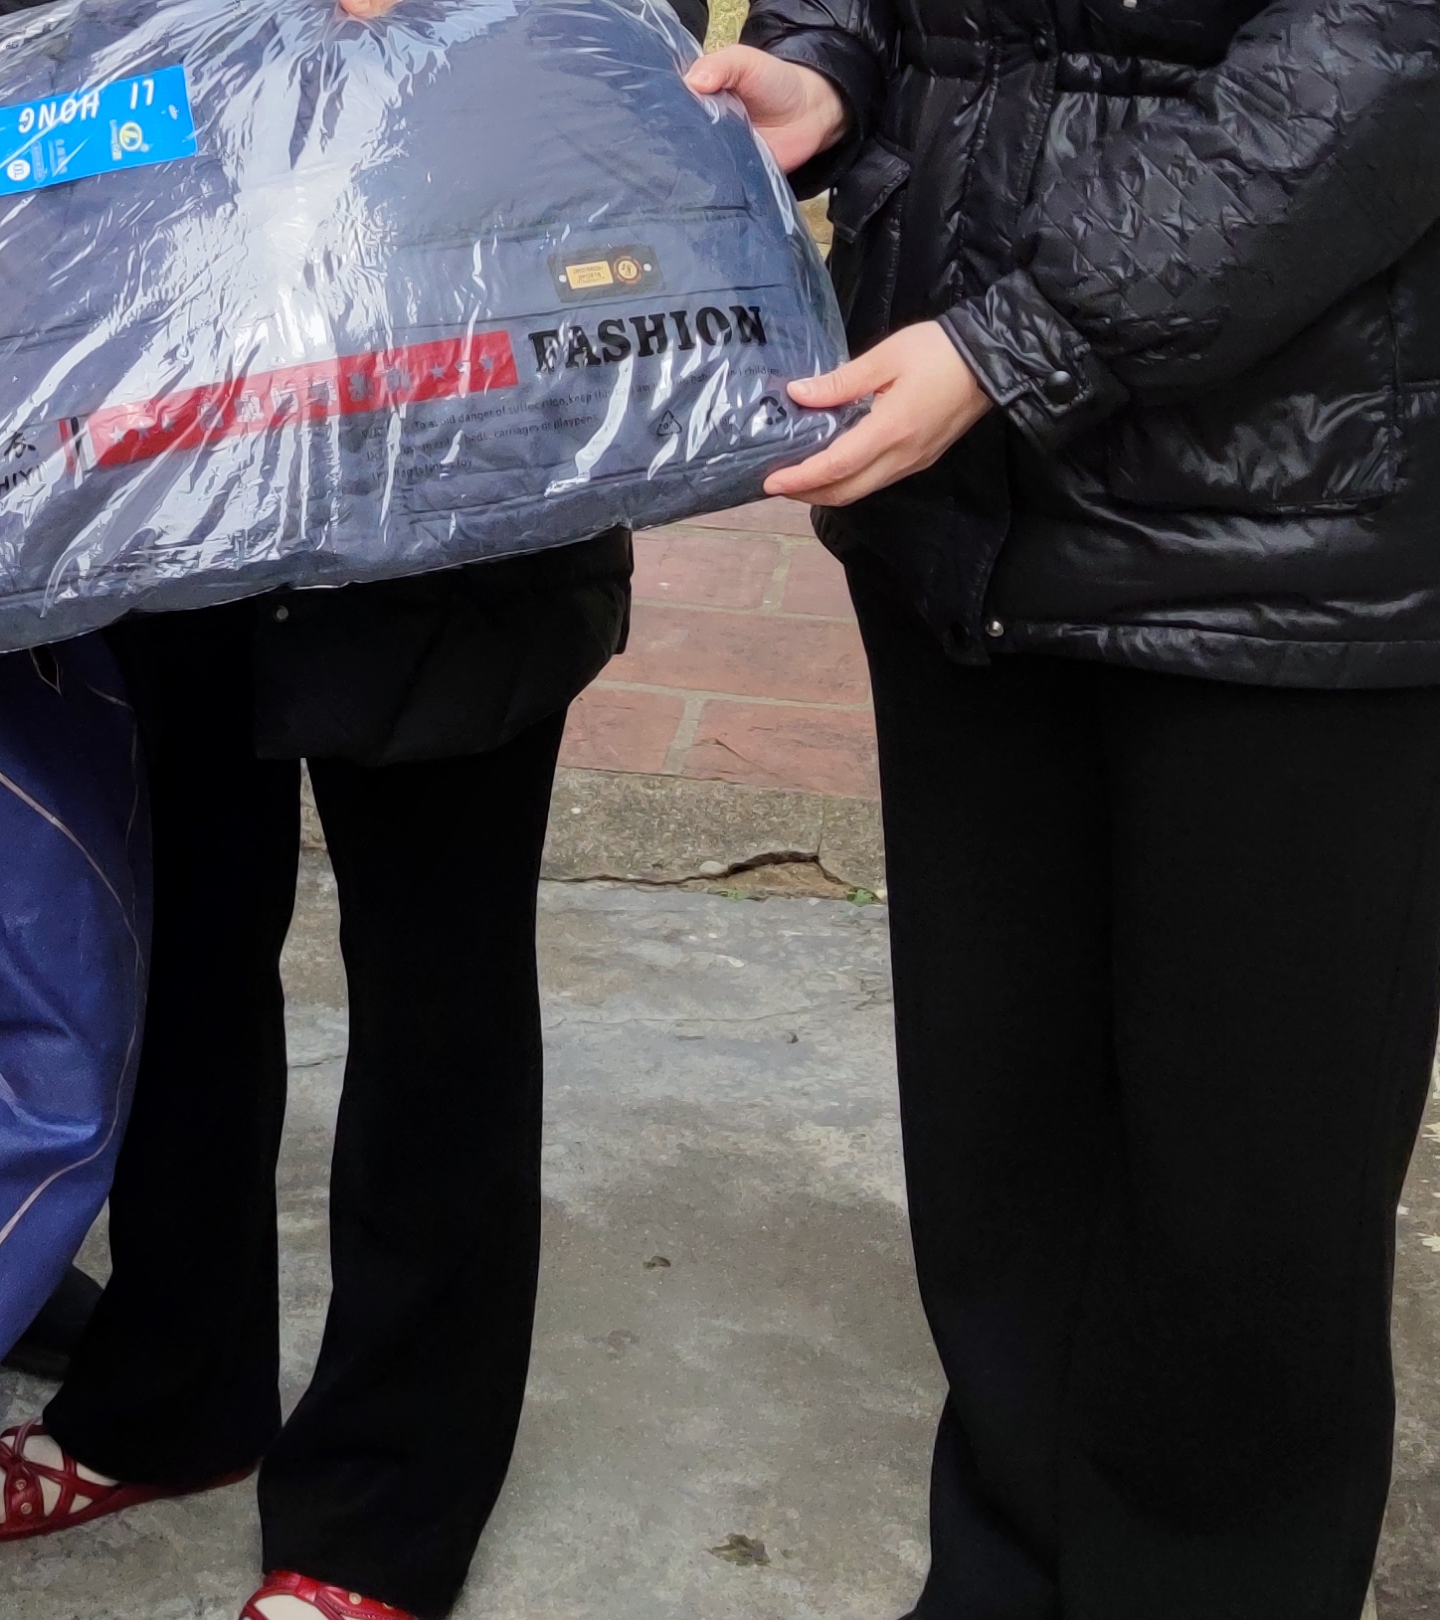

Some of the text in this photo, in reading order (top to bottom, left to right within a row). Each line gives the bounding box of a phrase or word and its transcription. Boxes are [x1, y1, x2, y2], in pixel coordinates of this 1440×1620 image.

[17, 90, 101, 135] HONG
[129, 78, 155, 110] LI
[528, 305, 767, 372] FASHION
[457, 407, 493, 425] danger
[494, 405, 506, 416] of
